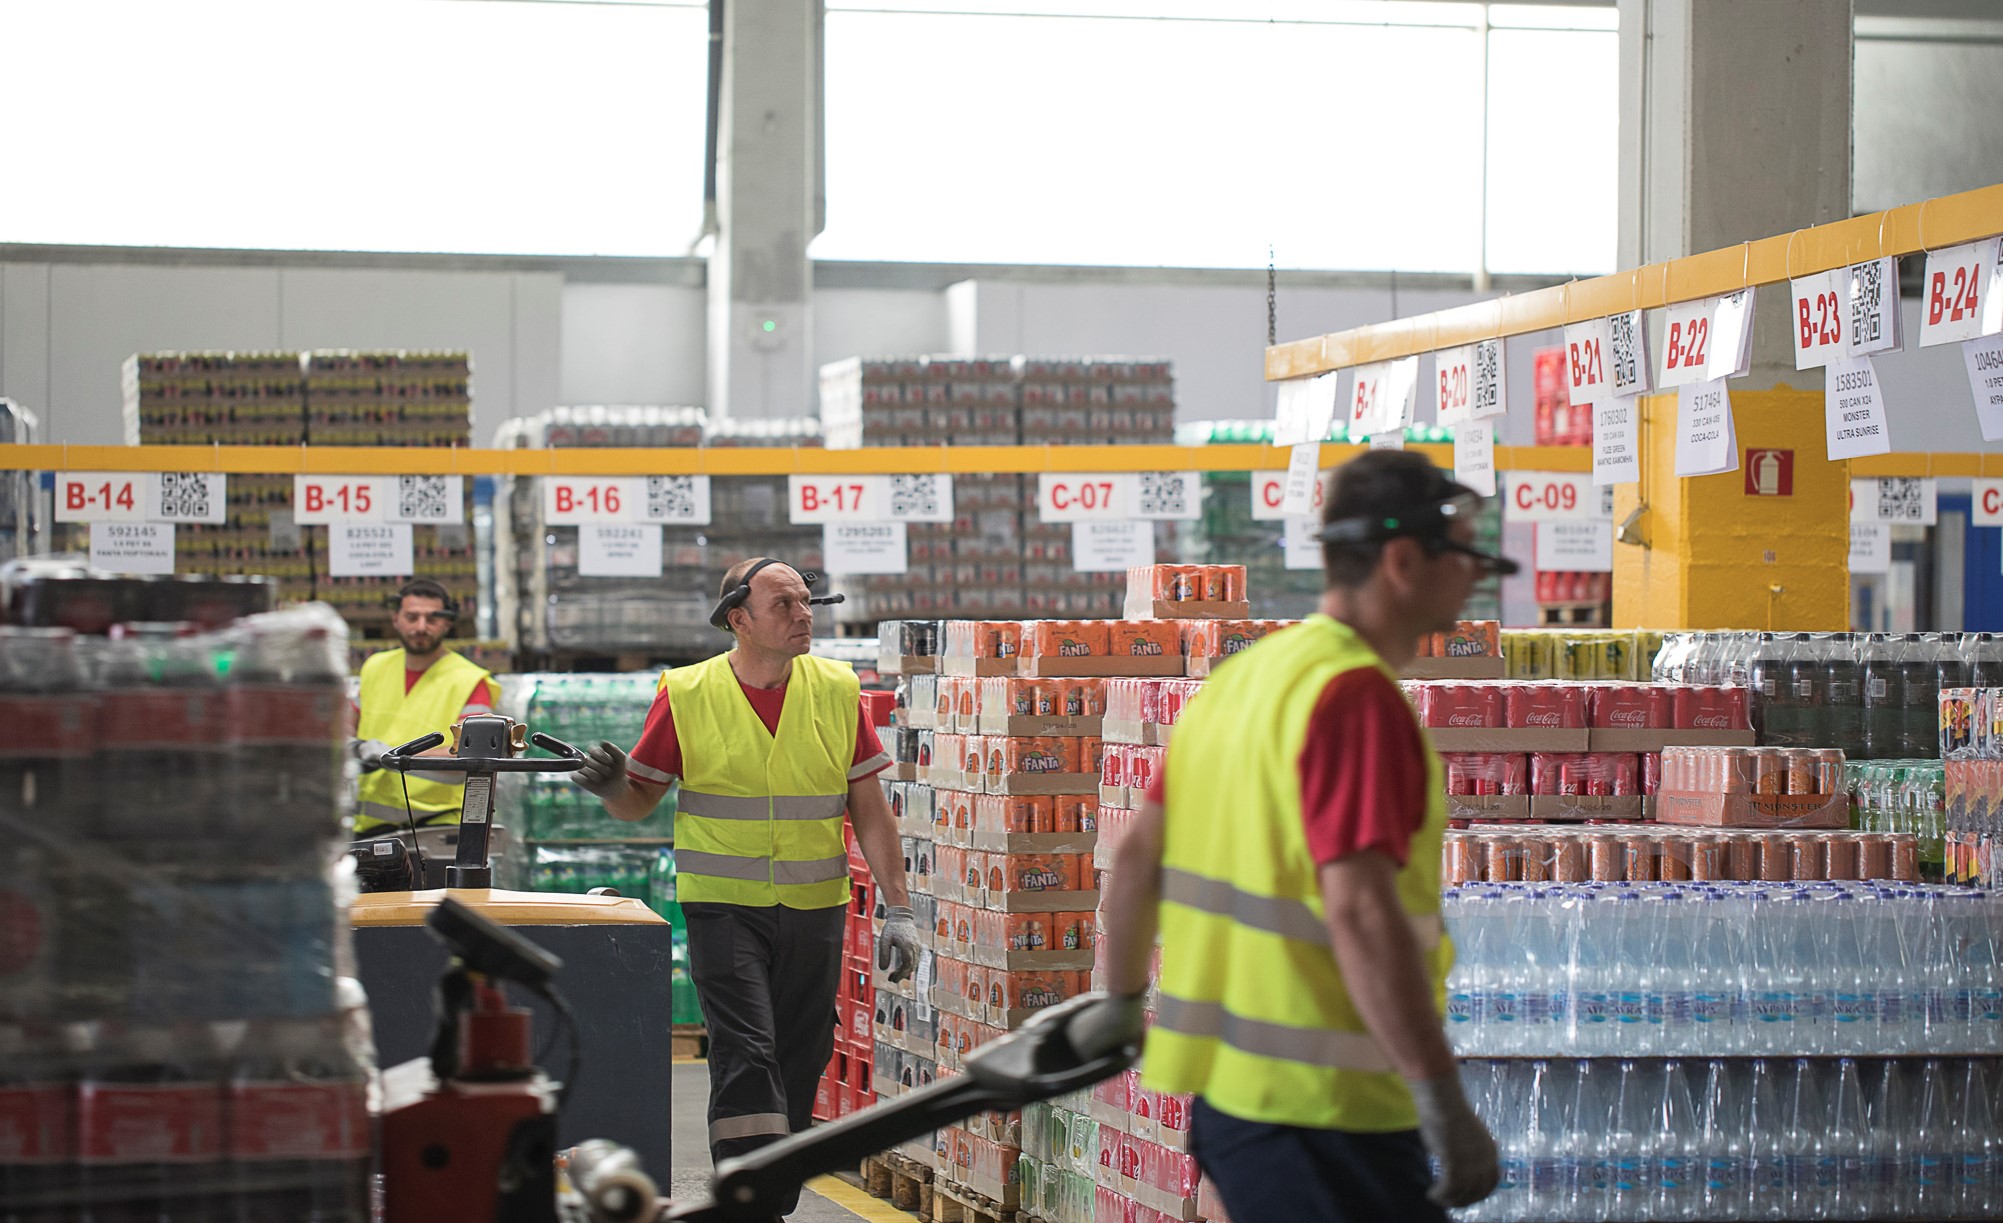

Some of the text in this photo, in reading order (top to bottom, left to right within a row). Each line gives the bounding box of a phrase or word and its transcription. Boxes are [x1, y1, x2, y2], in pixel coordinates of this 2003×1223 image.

[1928, 263, 1980, 326] B-24
[1798, 291, 1841, 349] B-23
[1667, 317, 1708, 370] B-22
[1570, 337, 1603, 388] B-21
[1441, 364, 1467, 410] B-20
[1835, 370, 1873, 393] 1583501
[1693, 390, 1721, 412] 517464
[1848, 397, 1861, 408] CAN
[1861, 394, 1872, 406] X24
[1600, 407, 1628, 427] 1760302
[1843, 409, 1871, 423] MONSTER
[1690, 430, 1720, 443] COCA-COLA
[1836, 424, 1880, 441] ULTRA SUNRISE
[66, 481, 135, 511] B-14
[305, 484, 372, 513] B-15
[555, 485, 621, 514] B-16
[800, 484, 864, 512] B-17
[1051, 482, 1114, 511] C-07
[1516, 482, 1577, 511] C-09
[108, 526, 157, 538] 592145
[1058, 643, 1091, 657] FANTA
[1129, 642, 1163, 656] FANTA
[1448, 641, 1483, 657] FANTA
[1023, 754, 1059, 771] FANTA
[1763, 800, 1821, 812] MONSTER
[1023, 872, 1059, 888] FANTA
[1025, 992, 1060, 1007] FANTA
